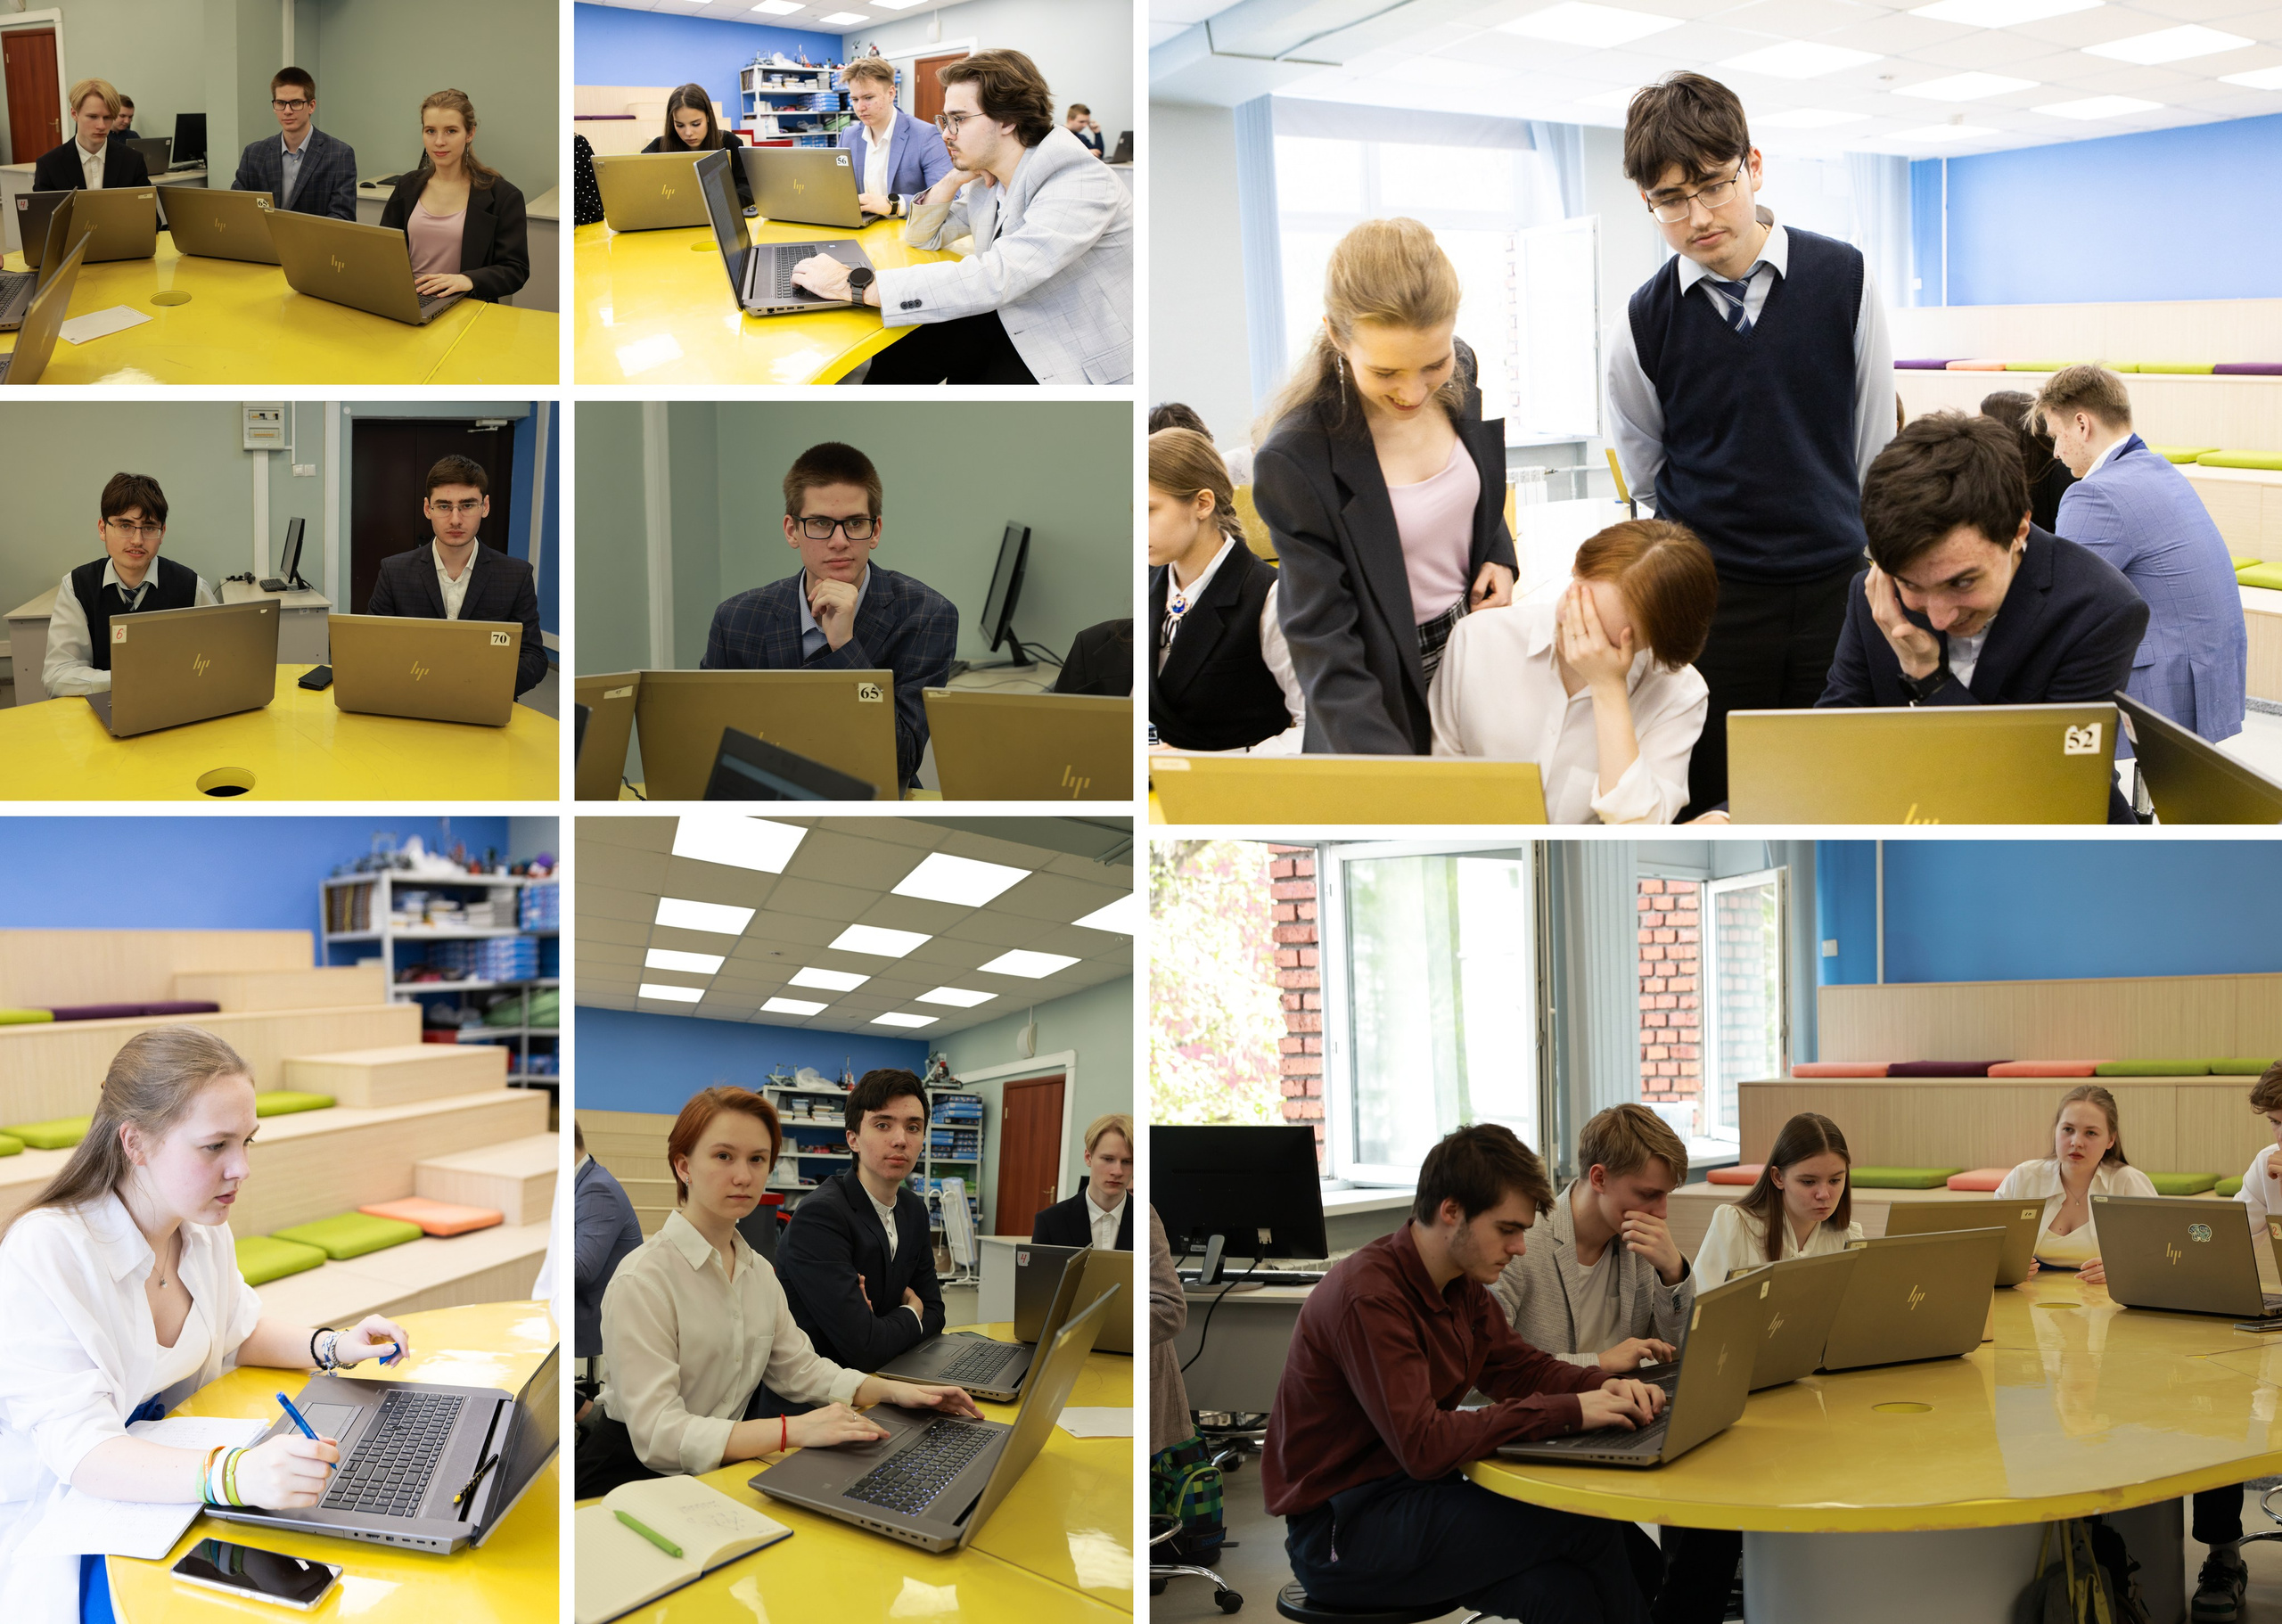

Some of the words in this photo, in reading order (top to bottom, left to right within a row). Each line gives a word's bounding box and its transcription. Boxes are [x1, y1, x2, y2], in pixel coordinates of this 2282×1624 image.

[837, 157, 847, 165] 56
[116, 628, 124, 640] 6
[492, 634, 507, 644] 70
[860, 686, 879, 700] 65
[2068, 731, 2093, 749] 52
[1020, 1253, 1027, 1264] 4
